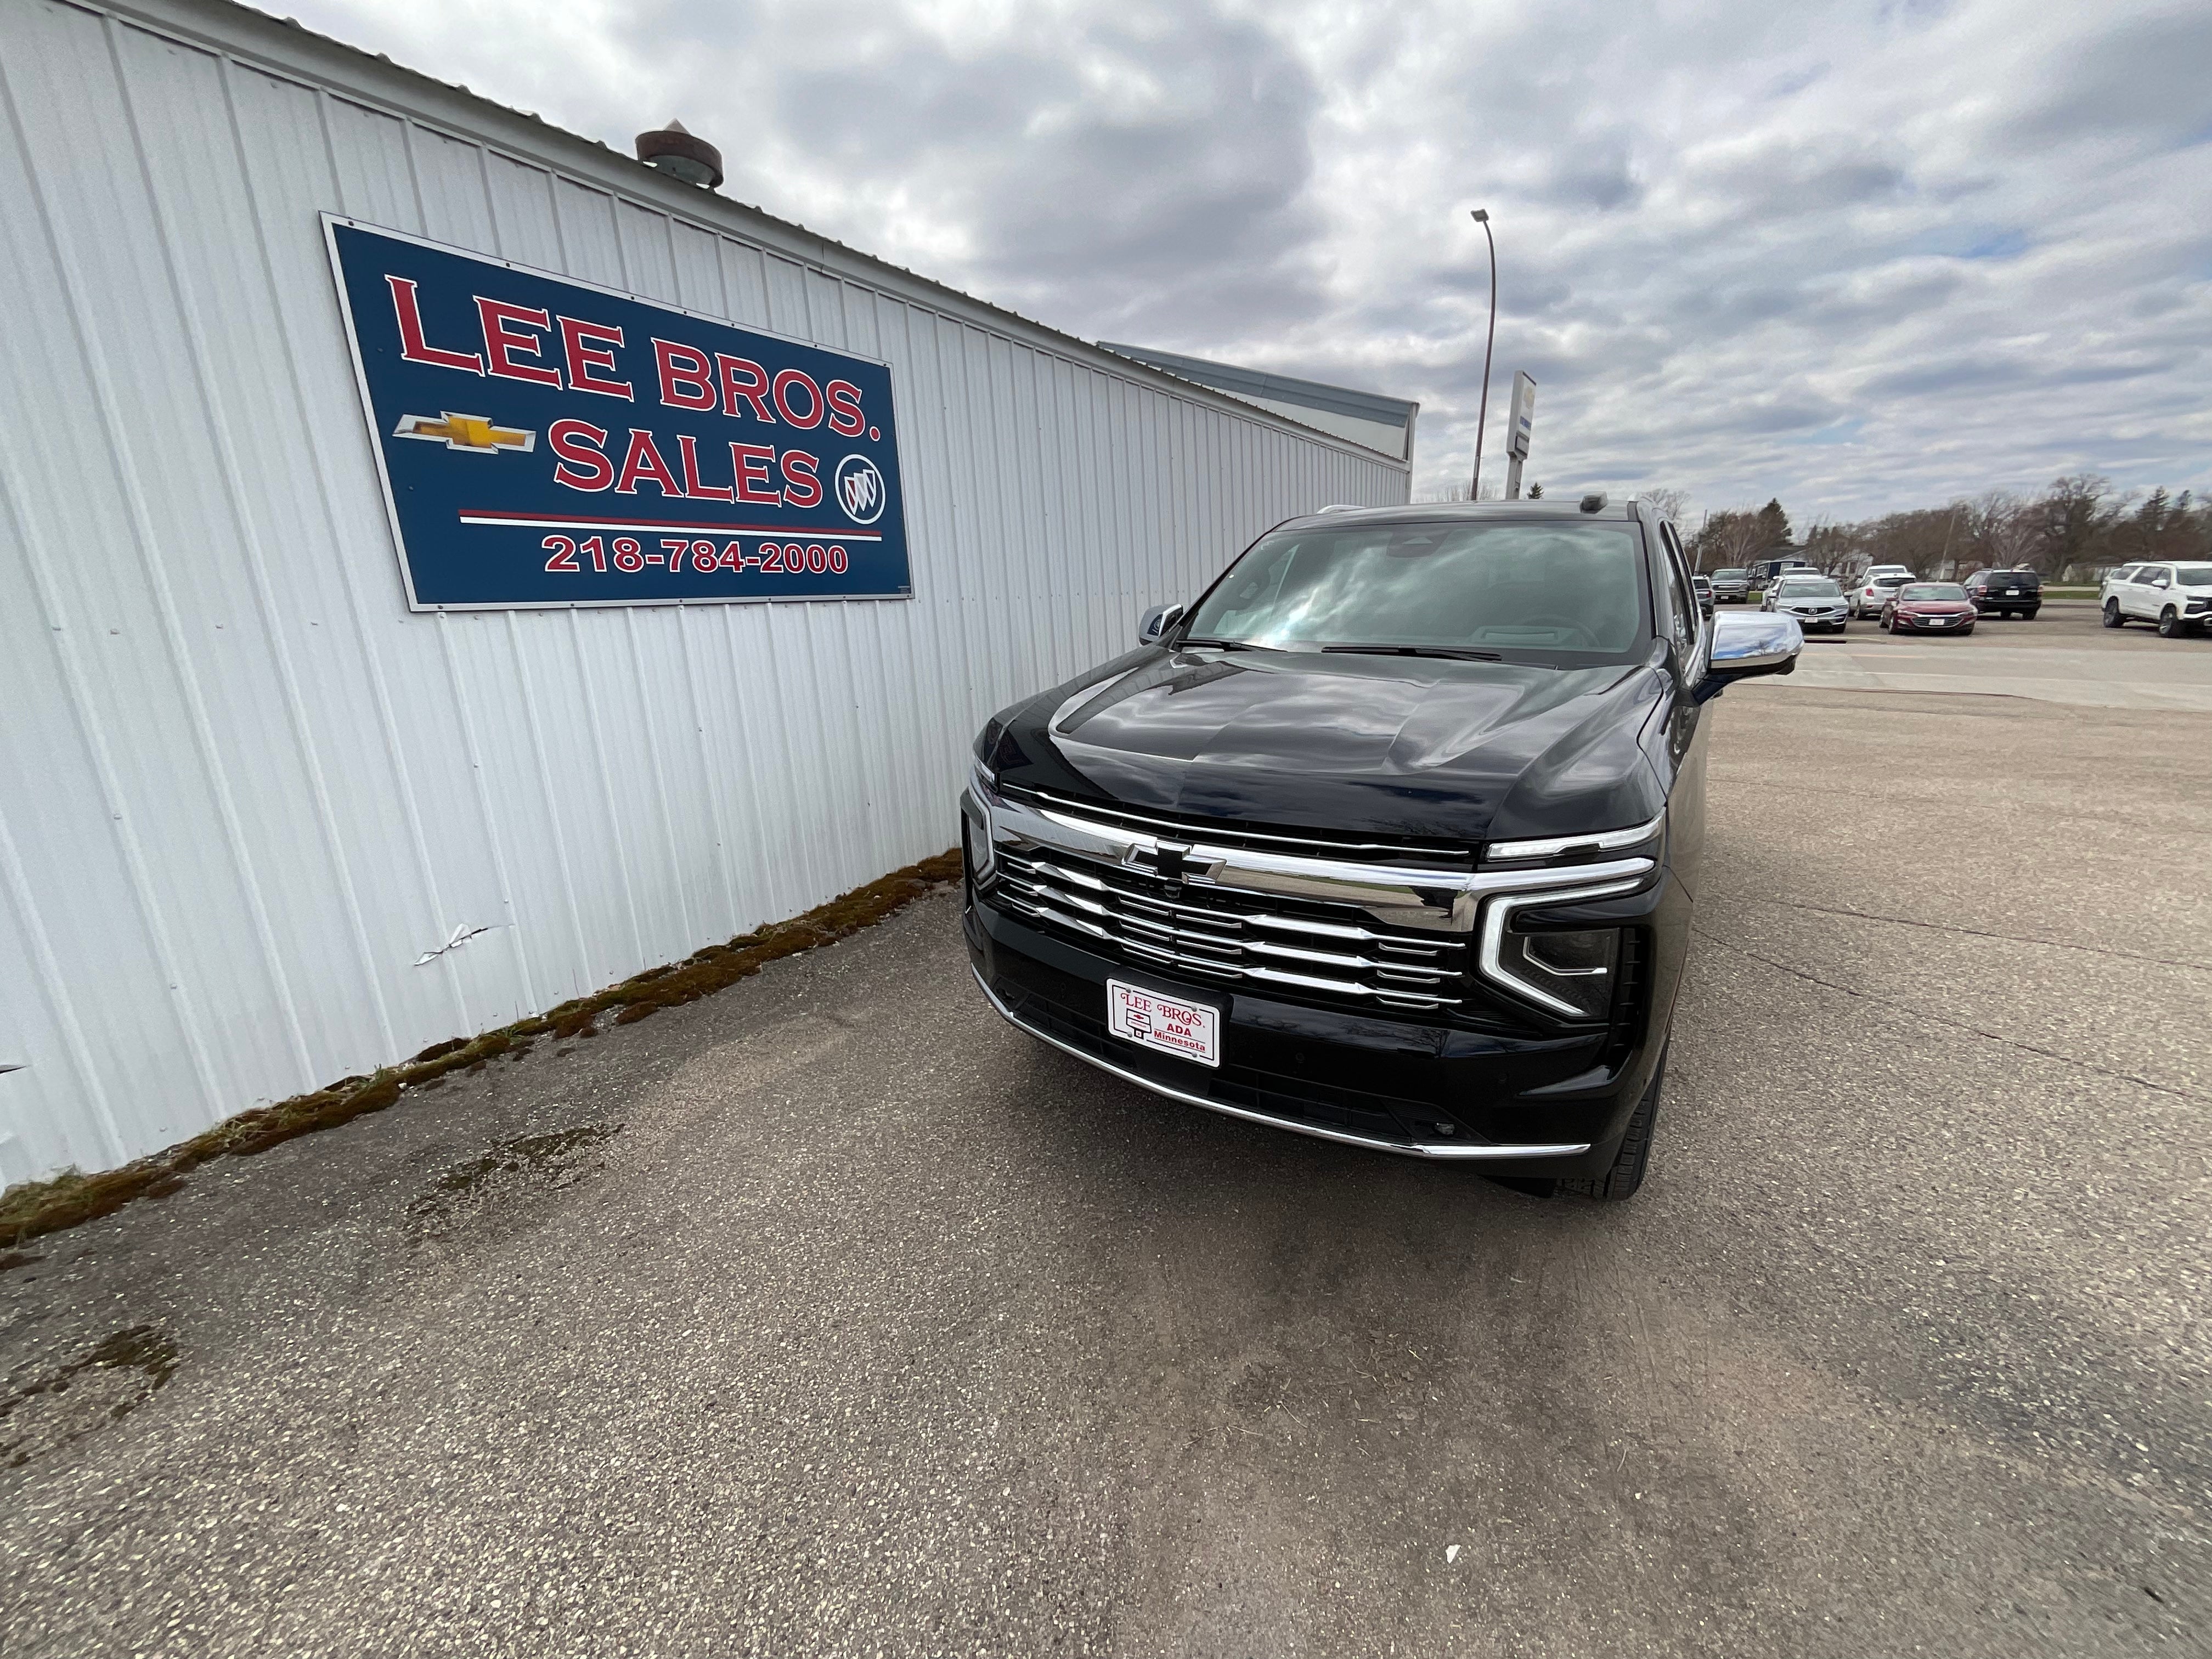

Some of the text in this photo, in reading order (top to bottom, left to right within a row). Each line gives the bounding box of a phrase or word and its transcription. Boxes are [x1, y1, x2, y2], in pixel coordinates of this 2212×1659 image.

[383, 274, 881, 442] LEE BROS.
[548, 418, 824, 508] SALES
[541, 534, 849, 574] 218-784-2000
[1120, 993, 1152, 1012] LEE
[1154, 1030, 1206, 1051] Minnesota
[1167, 1023, 1192, 1037] ADA
